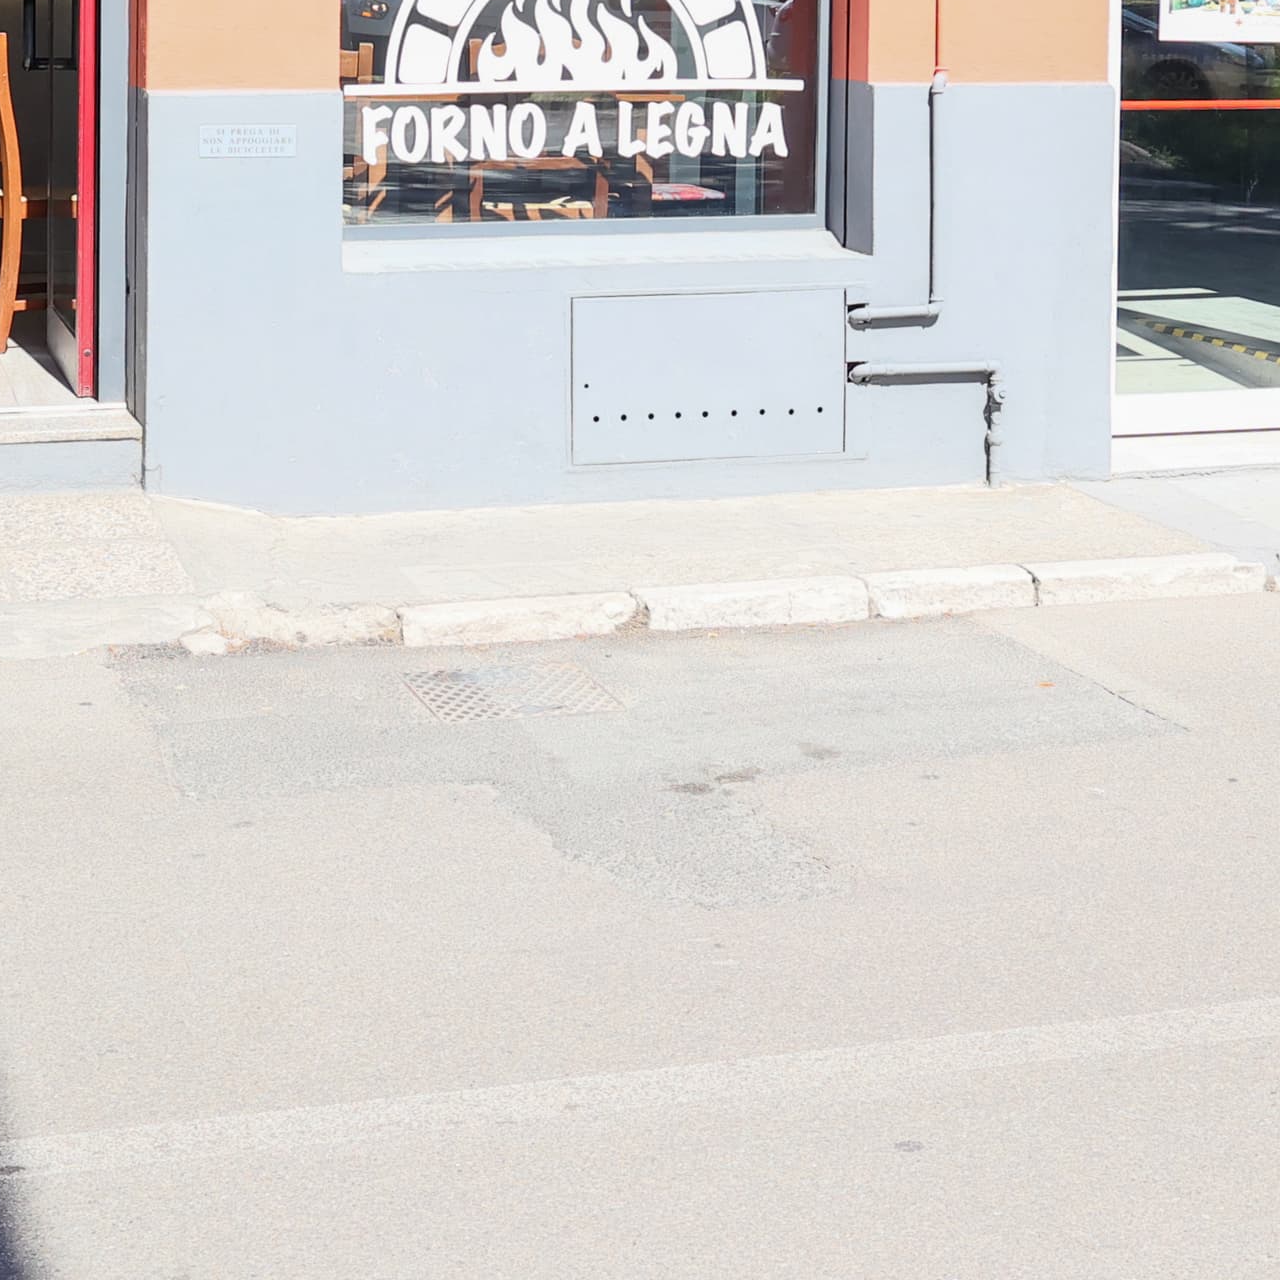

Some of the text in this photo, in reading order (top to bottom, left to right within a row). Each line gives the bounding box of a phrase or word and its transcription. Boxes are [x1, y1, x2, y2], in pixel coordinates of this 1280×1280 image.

[362, 101, 789, 166] FORNO A LEGNA
